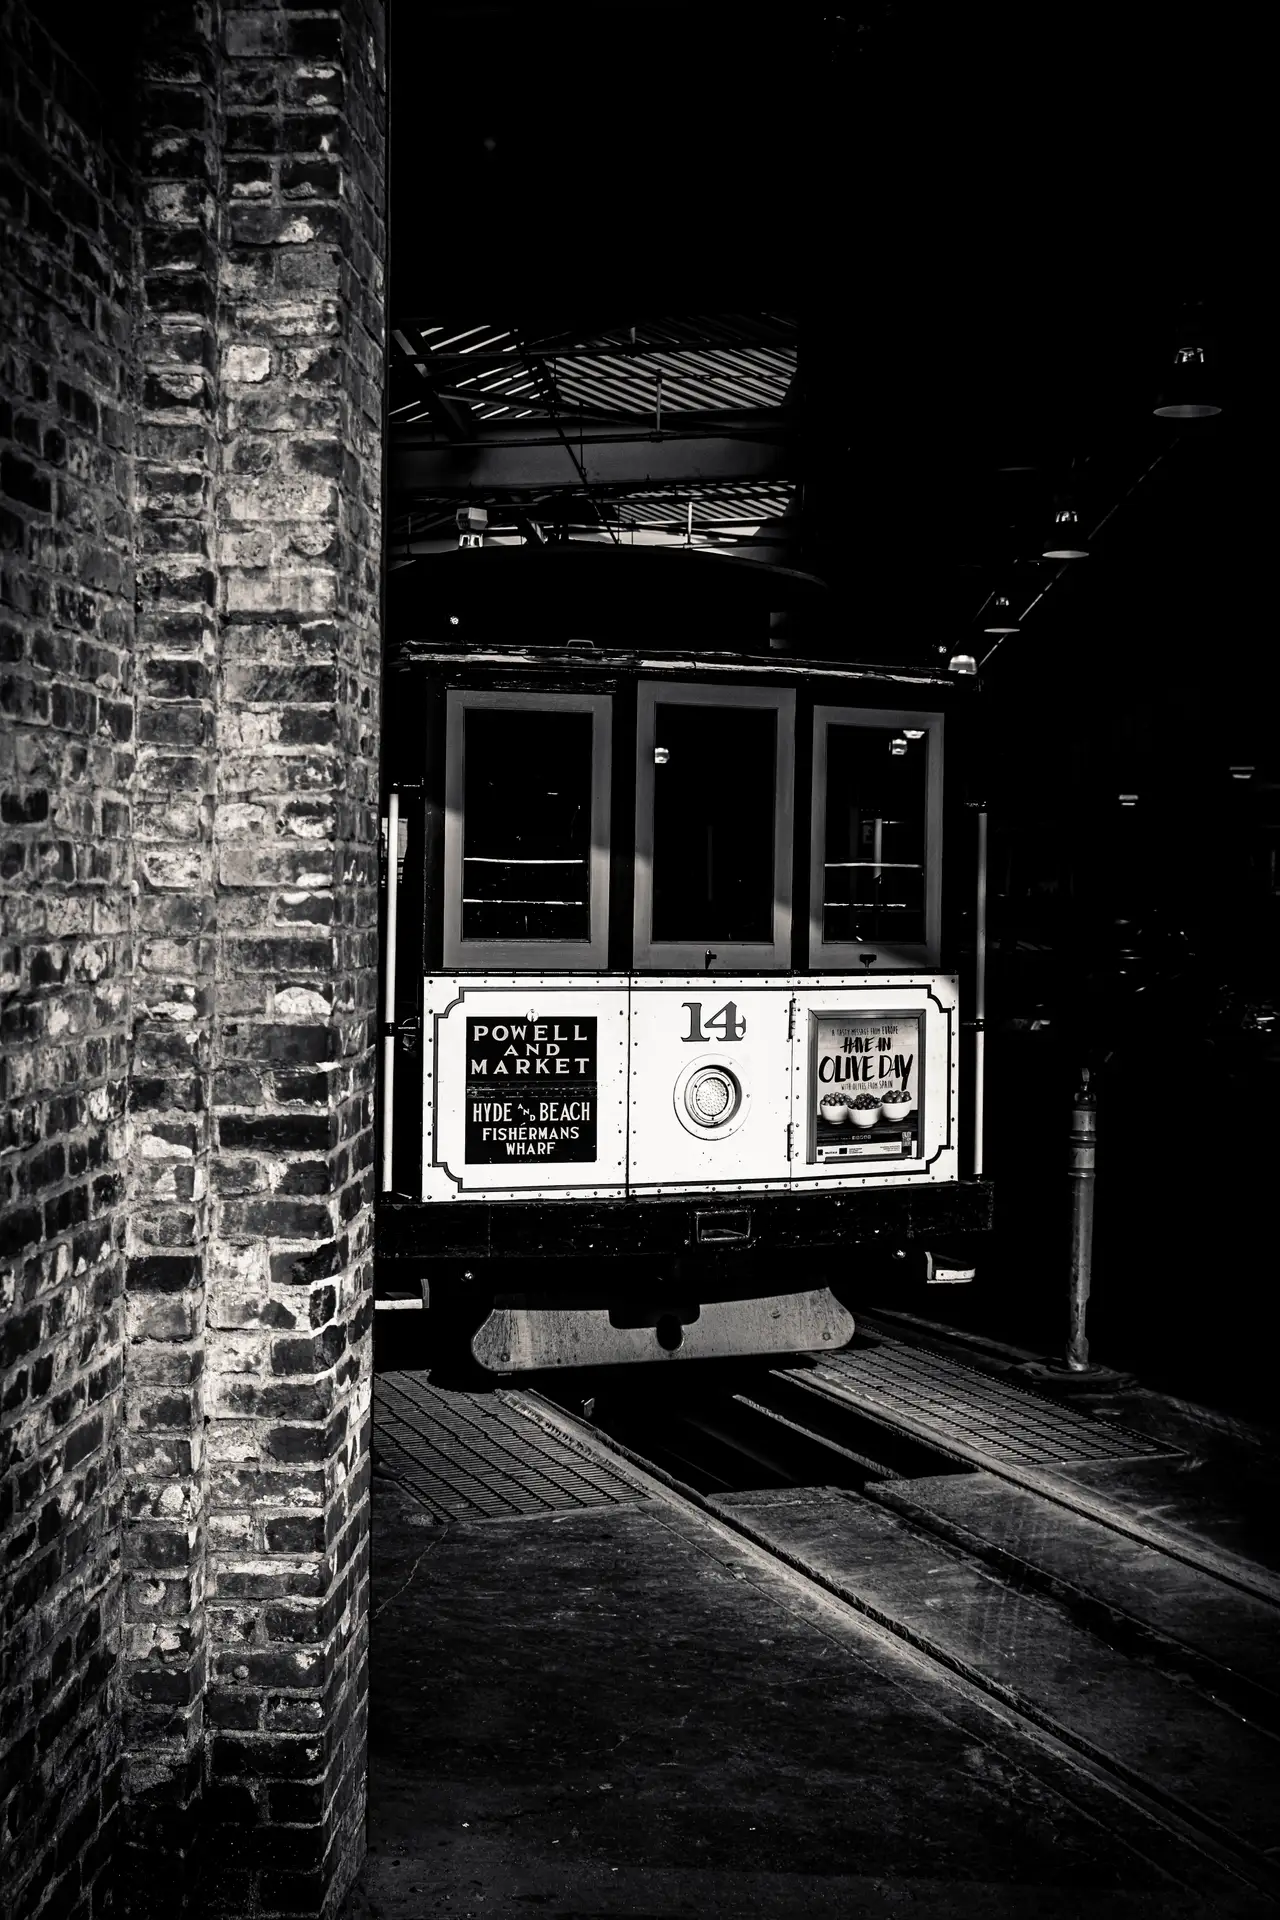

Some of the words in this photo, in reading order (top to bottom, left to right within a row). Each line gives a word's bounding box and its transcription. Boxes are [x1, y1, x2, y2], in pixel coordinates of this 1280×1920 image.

[680, 1000, 747, 1042] 14
[473, 1024, 588, 1042] POWELL
[881, 1025, 899, 1035] EUROPE
[503, 1043, 561, 1056] AND
[840, 1036, 874, 1054] HAVE
[471, 1058, 590, 1075] MARKET
[818, 1055, 874, 1083] OLIVE
[878, 1054, 914, 1091] DAY
[878, 1080, 894, 1089] SPAIN
[473, 1103, 513, 1122] HYDE
[517, 1103, 536, 1122] AND
[539, 1102, 590, 1122] BEACH
[482, 1126, 580, 1141] FISHERMANS
[505, 1142, 556, 1155] WHARF
